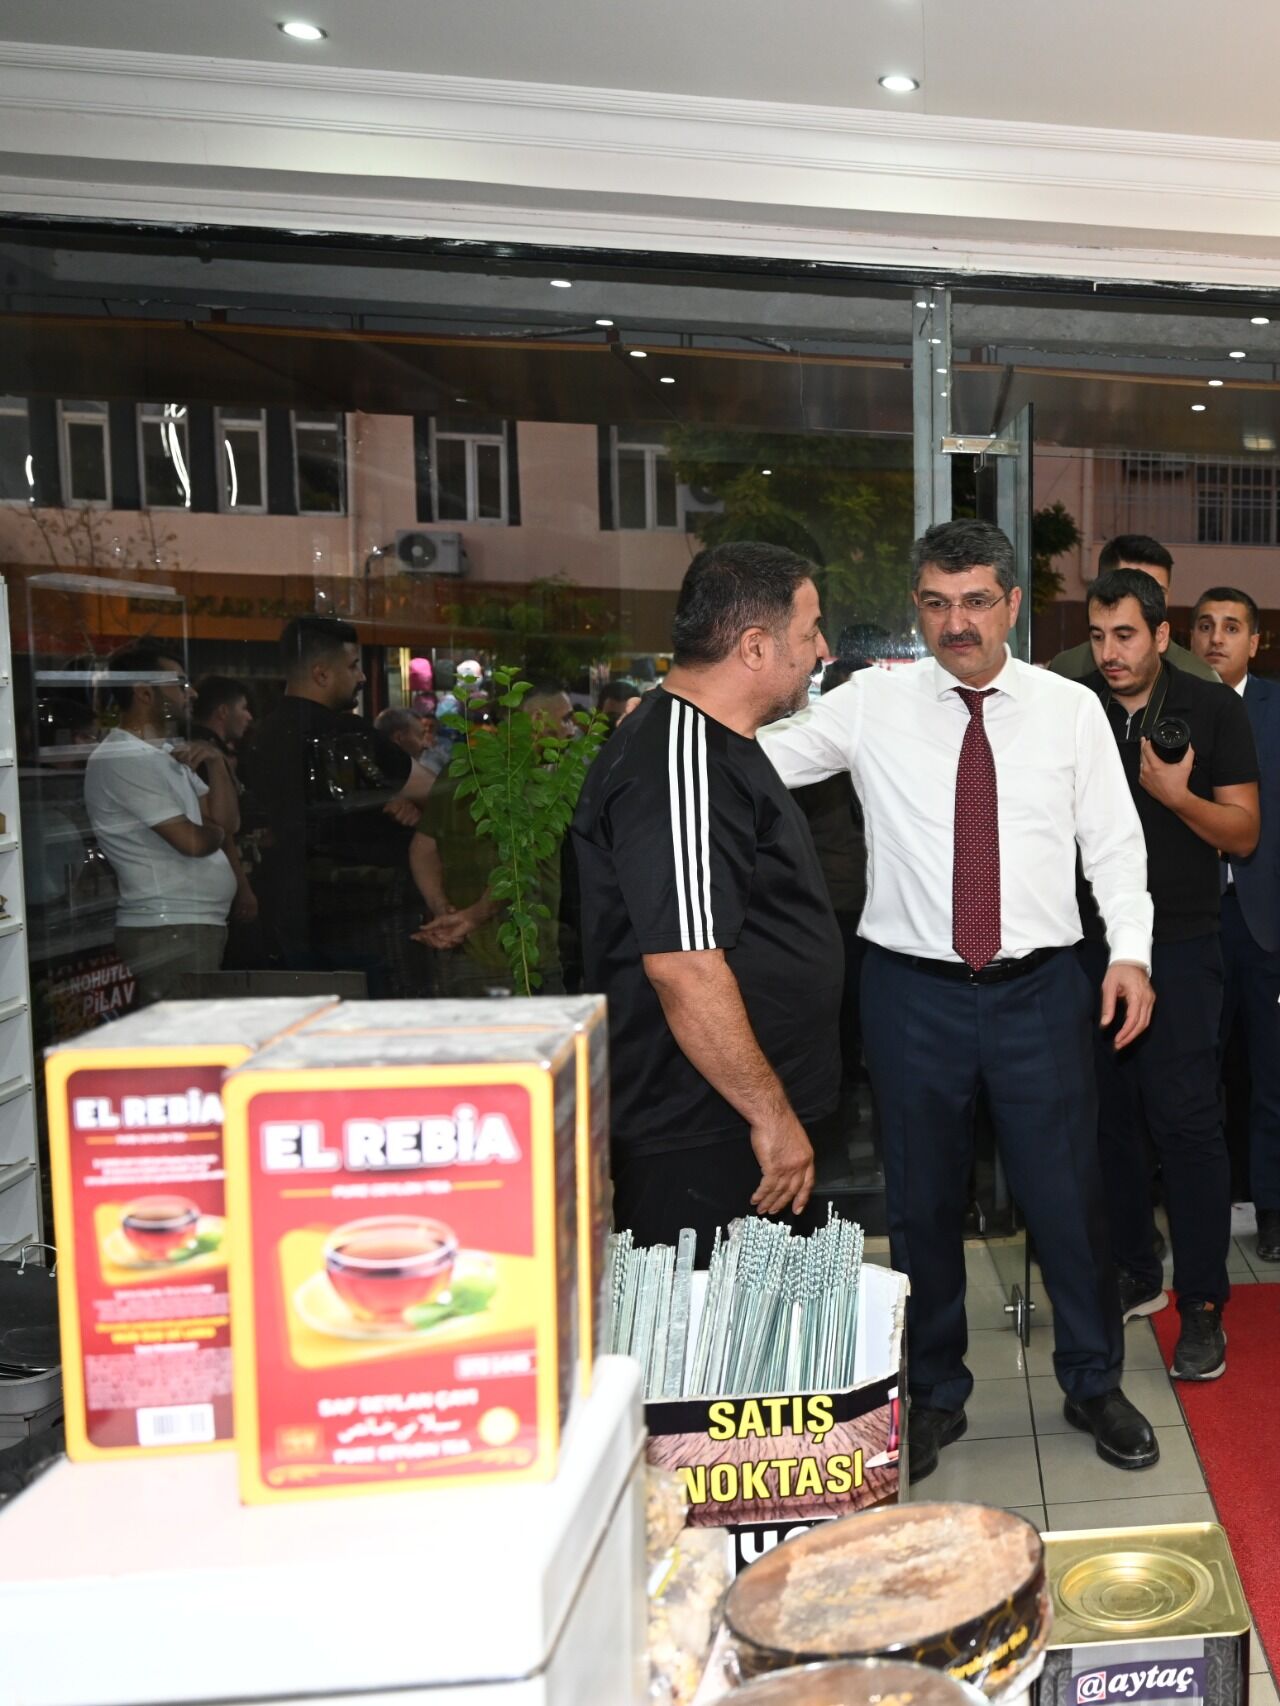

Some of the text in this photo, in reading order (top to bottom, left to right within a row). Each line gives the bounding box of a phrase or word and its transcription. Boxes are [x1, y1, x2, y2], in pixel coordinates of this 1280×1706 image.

[74, 1097, 121, 1130] EL
[262, 1121, 341, 1171] EL
[346, 1105, 521, 1171] REBİA
[707, 1394, 835, 1445] SATIŞ
[677, 1448, 864, 1504] NOKTASI
